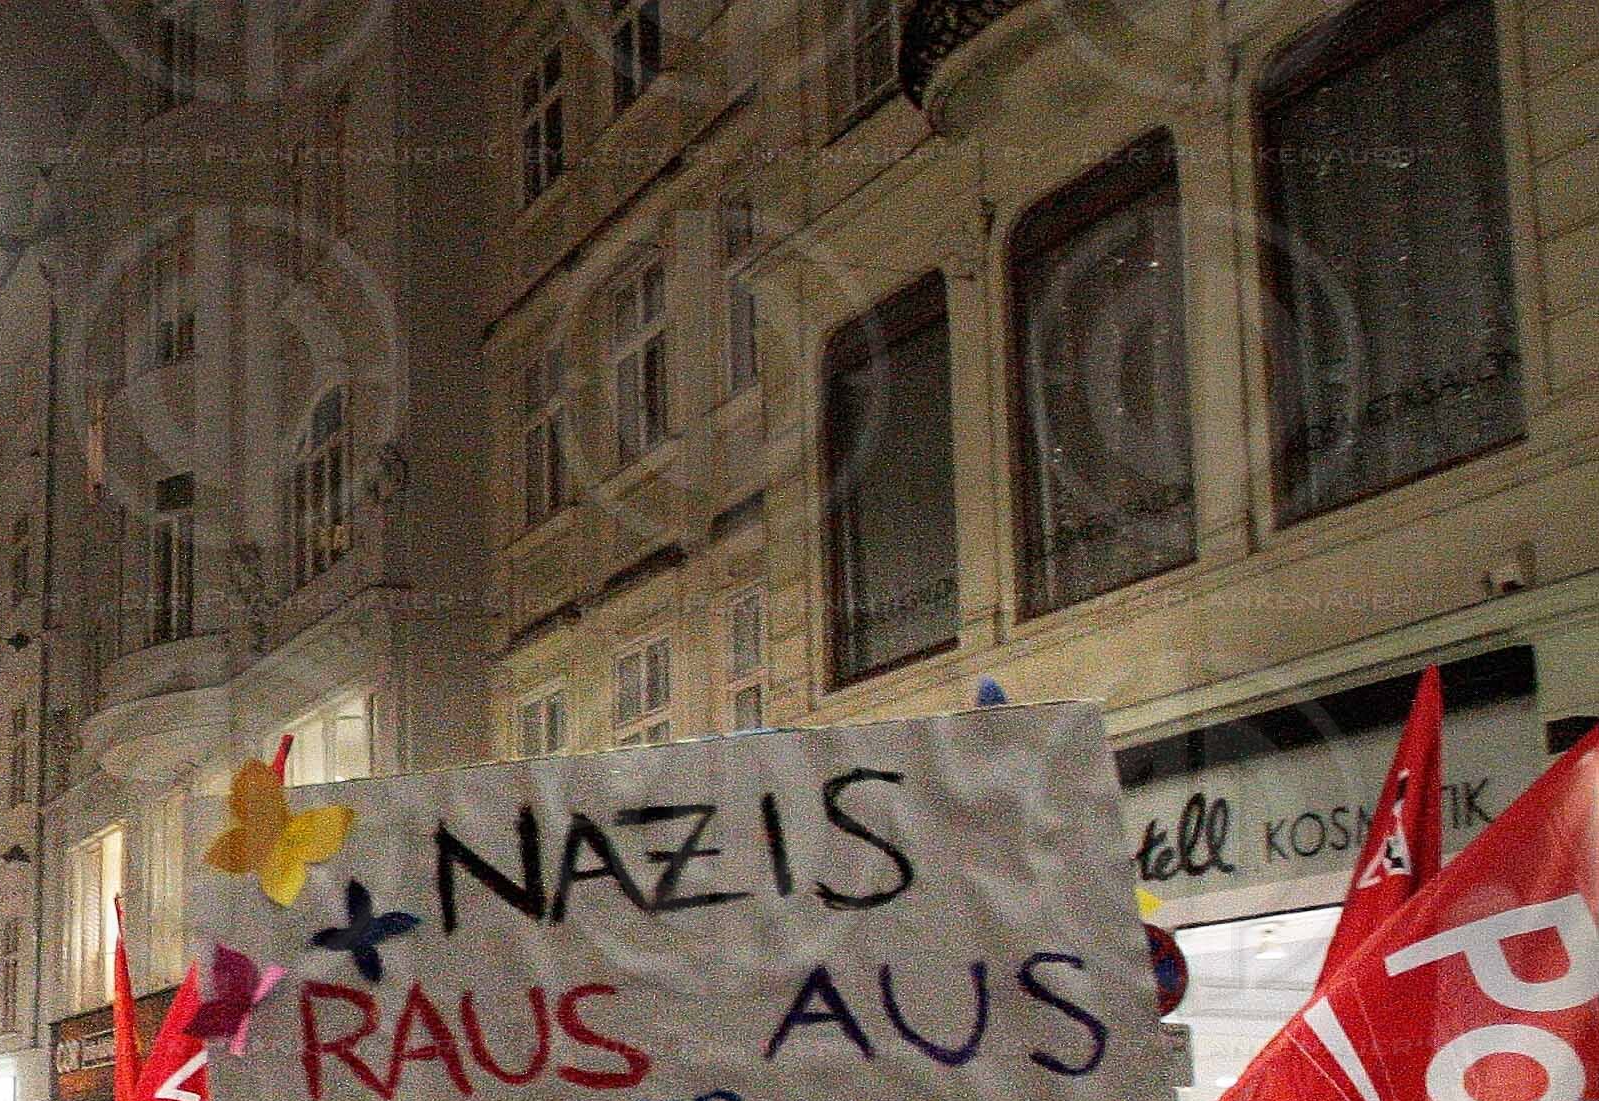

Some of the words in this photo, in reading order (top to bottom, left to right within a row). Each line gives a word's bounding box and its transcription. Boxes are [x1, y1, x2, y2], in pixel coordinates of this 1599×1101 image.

[436, 767, 914, 932] NAZIS
[1132, 791, 1236, 881] tell
[1264, 776, 1493, 864] KOSIK
[765, 952, 1109, 1077] AUS
